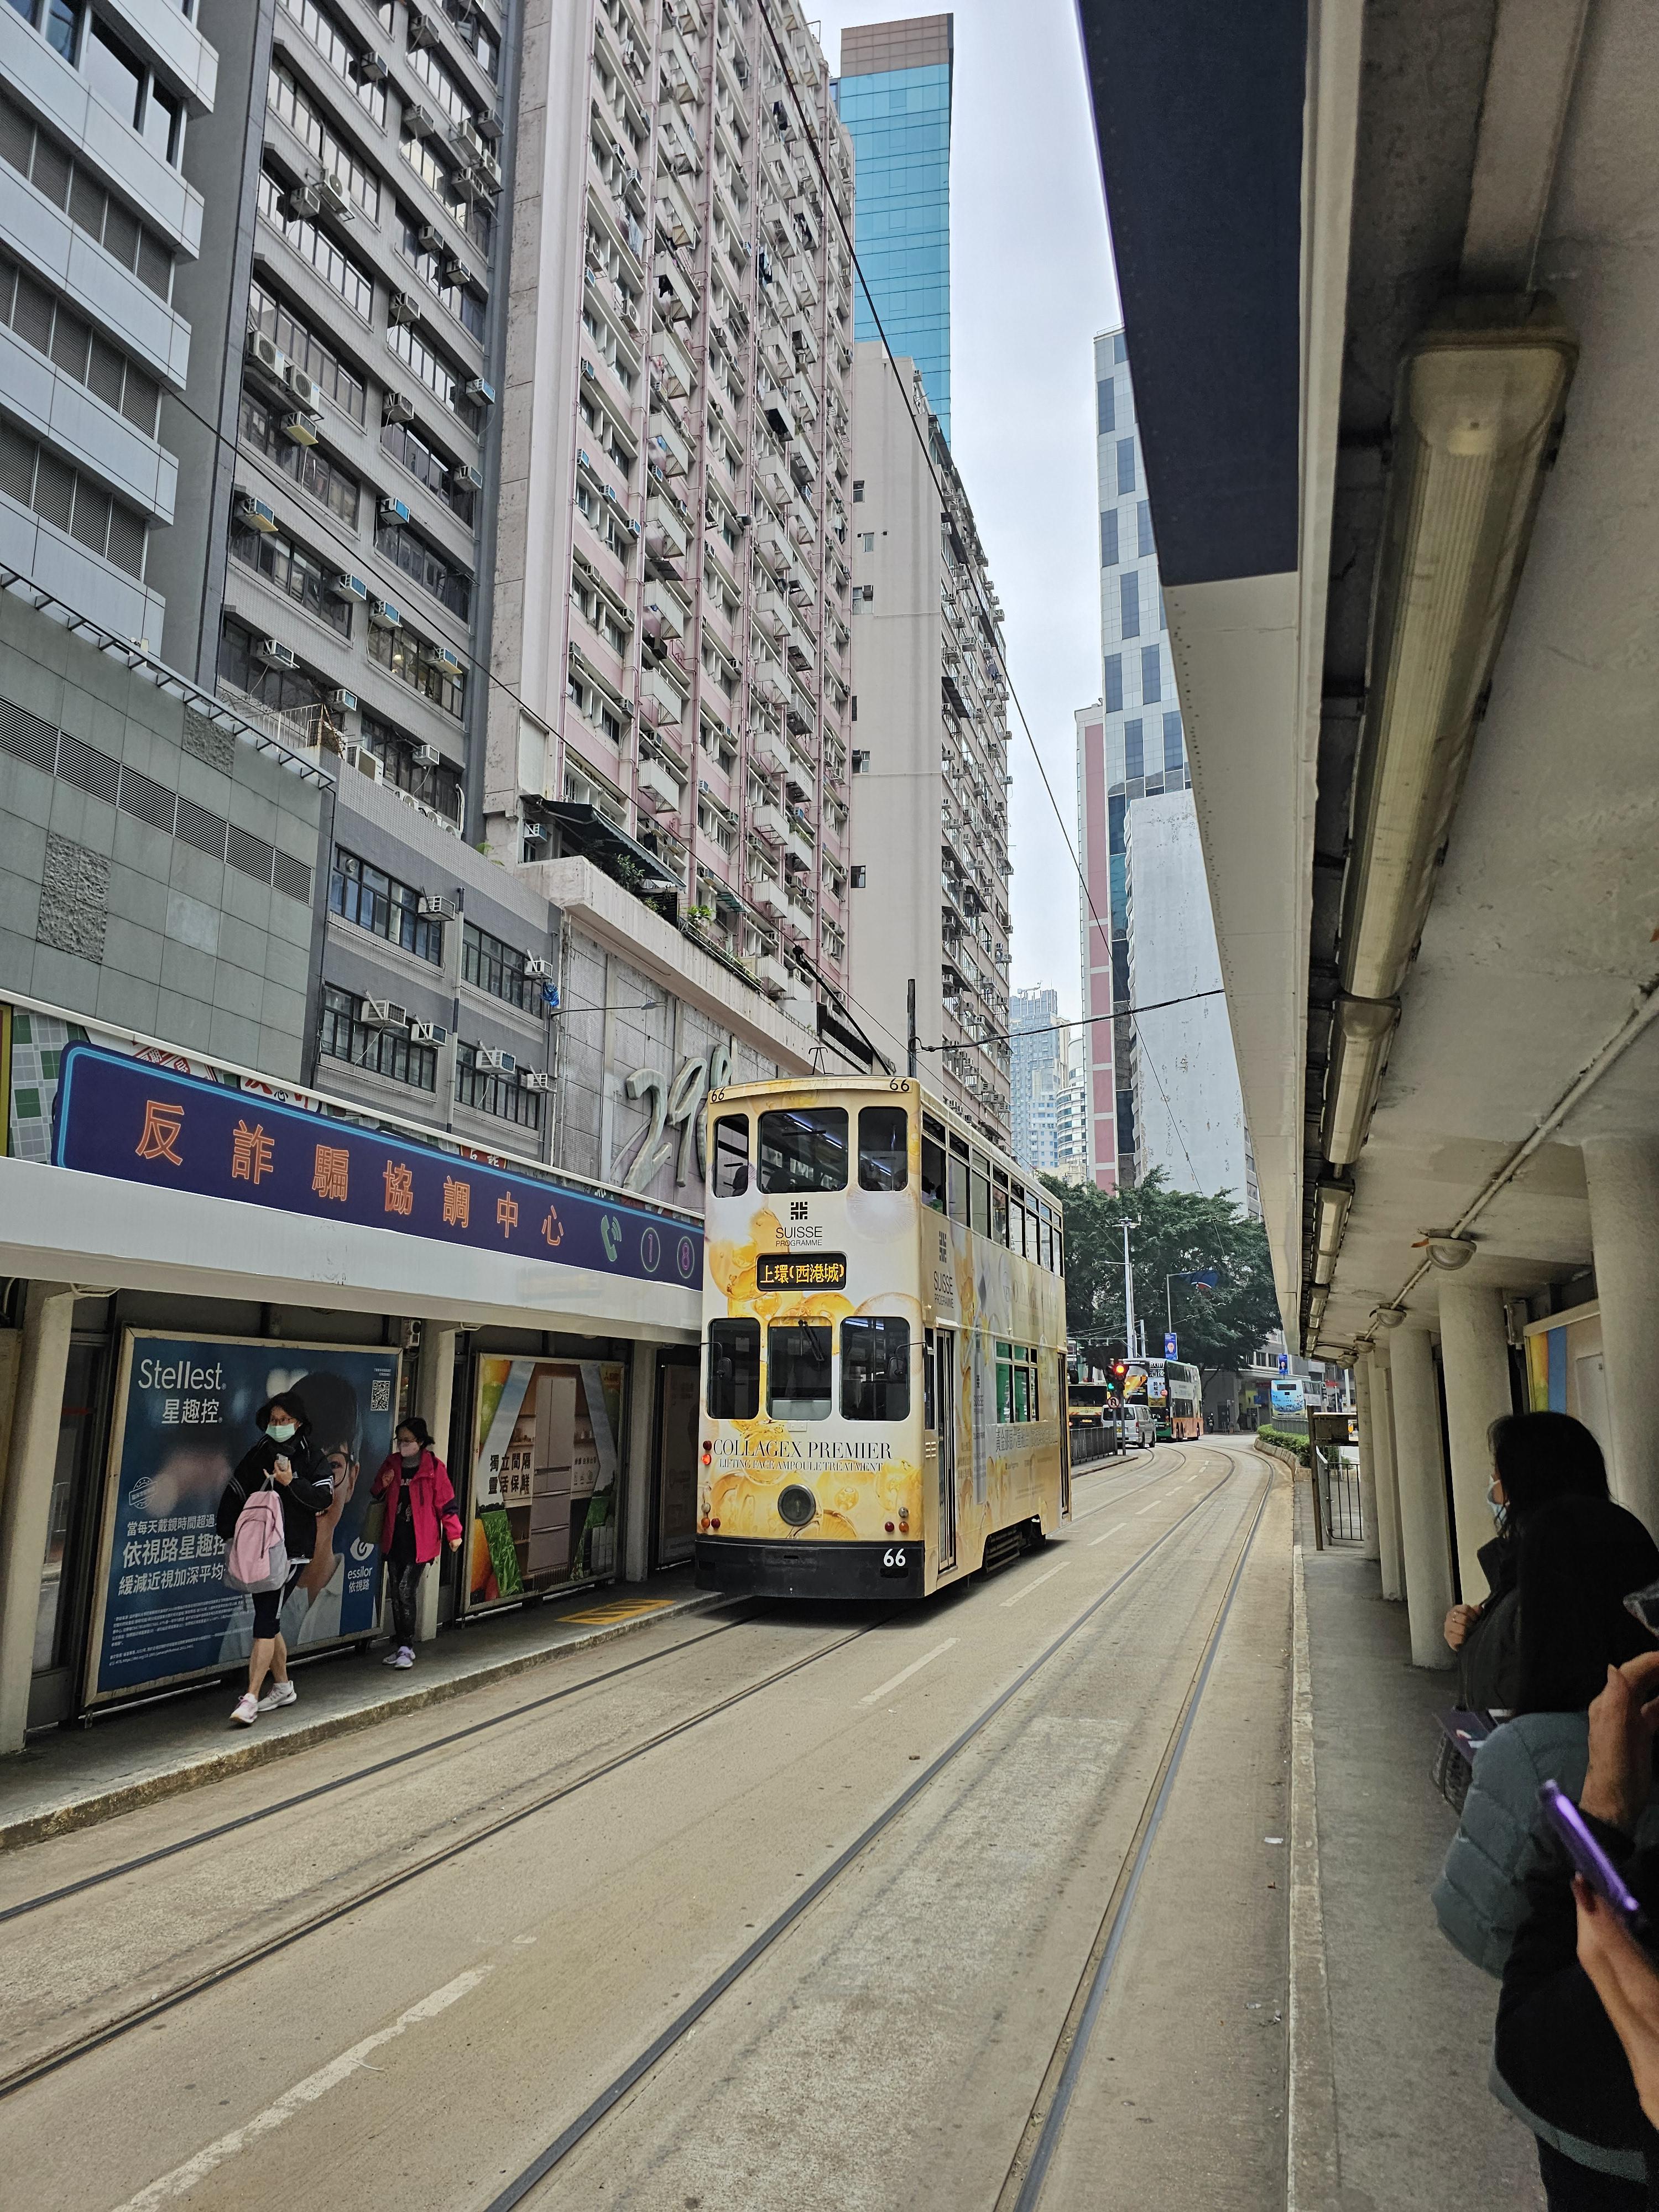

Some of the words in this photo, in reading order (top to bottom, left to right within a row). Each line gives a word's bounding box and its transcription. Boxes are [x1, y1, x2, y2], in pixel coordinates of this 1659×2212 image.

[711, 1088, 724, 1102] 66
[889, 1078, 910, 1092] 66
[135, 1100, 564, 1247] 反詐騙協調中心
[775, 1226, 823, 1239] SUISSE
[760, 1262, 844, 1284] 上環(西港城)
[933, 1271, 953, 1295] SUISSE
[161, 1398, 220, 1424] 星趣控
[713, 1439, 802, 1458] COLLAGEX
[807, 1442, 893, 1459] PREMIER
[719, 1459, 751, 1469] LIFTING
[753, 1460, 774, 1470] FACE
[777, 1461, 822, 1471] AMPOULE
[822, 1462, 884, 1473] TREATMENT
[127, 1514, 217, 1537] 當每天戴鏡時間超過
[883, 1549, 906, 1567] 66
[118, 1562, 226, 1597] 緩減近視加深平均
[347, 1566, 373, 1579] essilor
